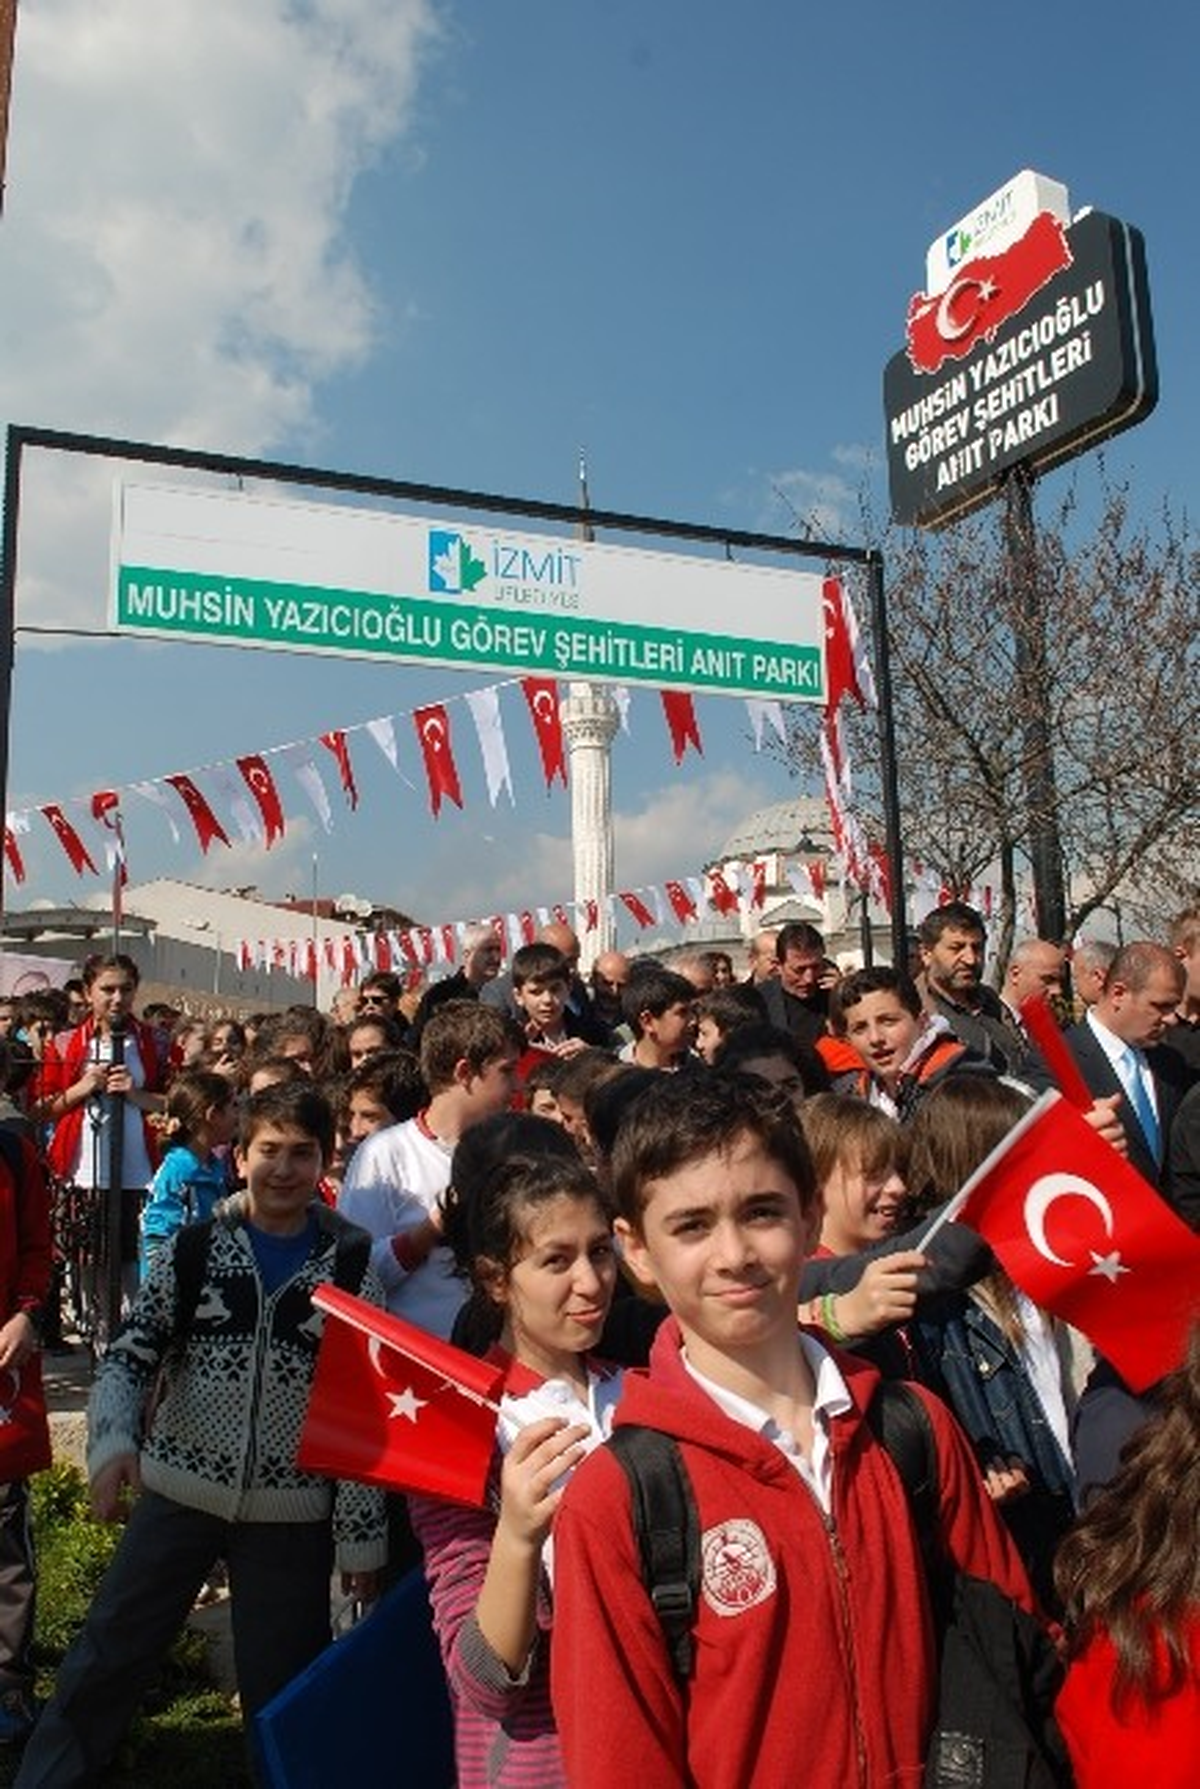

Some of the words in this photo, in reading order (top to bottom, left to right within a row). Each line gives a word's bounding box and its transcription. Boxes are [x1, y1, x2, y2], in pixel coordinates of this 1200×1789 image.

[970, 281, 1104, 391] YAZICIOĞLU
[905, 407, 969, 470] GÖREV
[974, 331, 1091, 431] ŞEHİTLERİ
[989, 393, 1058, 460] PARKI
[494, 540, 580, 587] İZMİT
[127, 583, 255, 627] MUHSİN
[264, 598, 441, 646] YAZICIOĞLU
[450, 615, 546, 657] GÖREV
[554, 629, 684, 672] ŞEHİTLERİ
[690, 647, 745, 680] ANIT
[753, 655, 820, 688] PARKI
